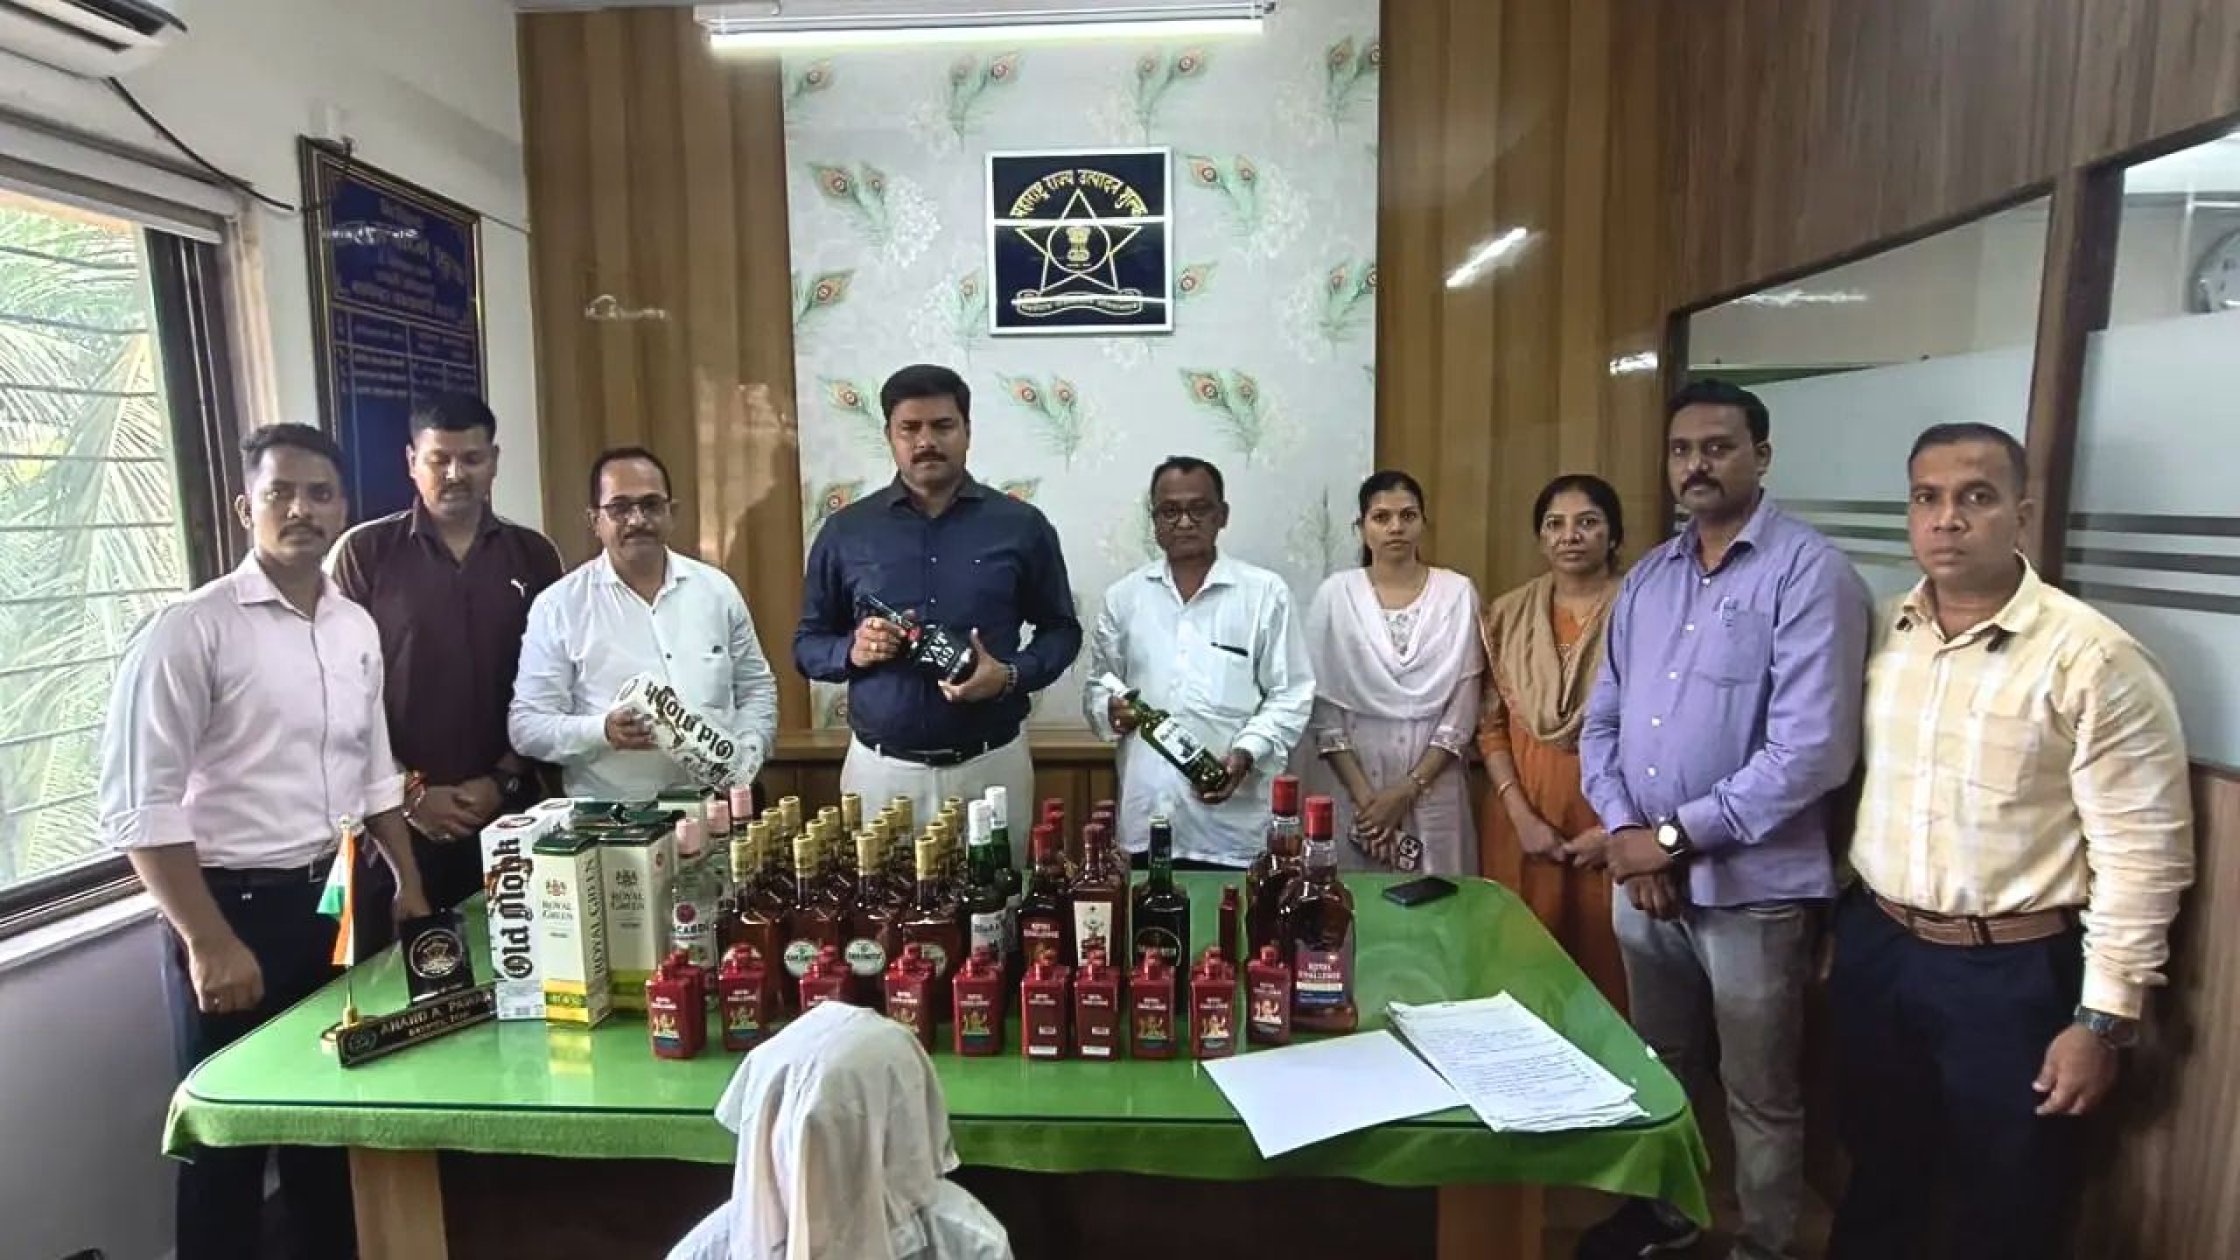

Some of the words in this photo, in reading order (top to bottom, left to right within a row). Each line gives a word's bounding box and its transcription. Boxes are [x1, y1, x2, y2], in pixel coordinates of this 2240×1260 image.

[1009, 181, 1050, 218] महाराष्ट्र
[1042, 169, 1074, 191] राज्य
[1077, 169, 1125, 196] उत्पादन
[1114, 185, 1149, 218] शुल्क
[697, 723, 735, 760] Old
[500, 926, 534, 980] Old
